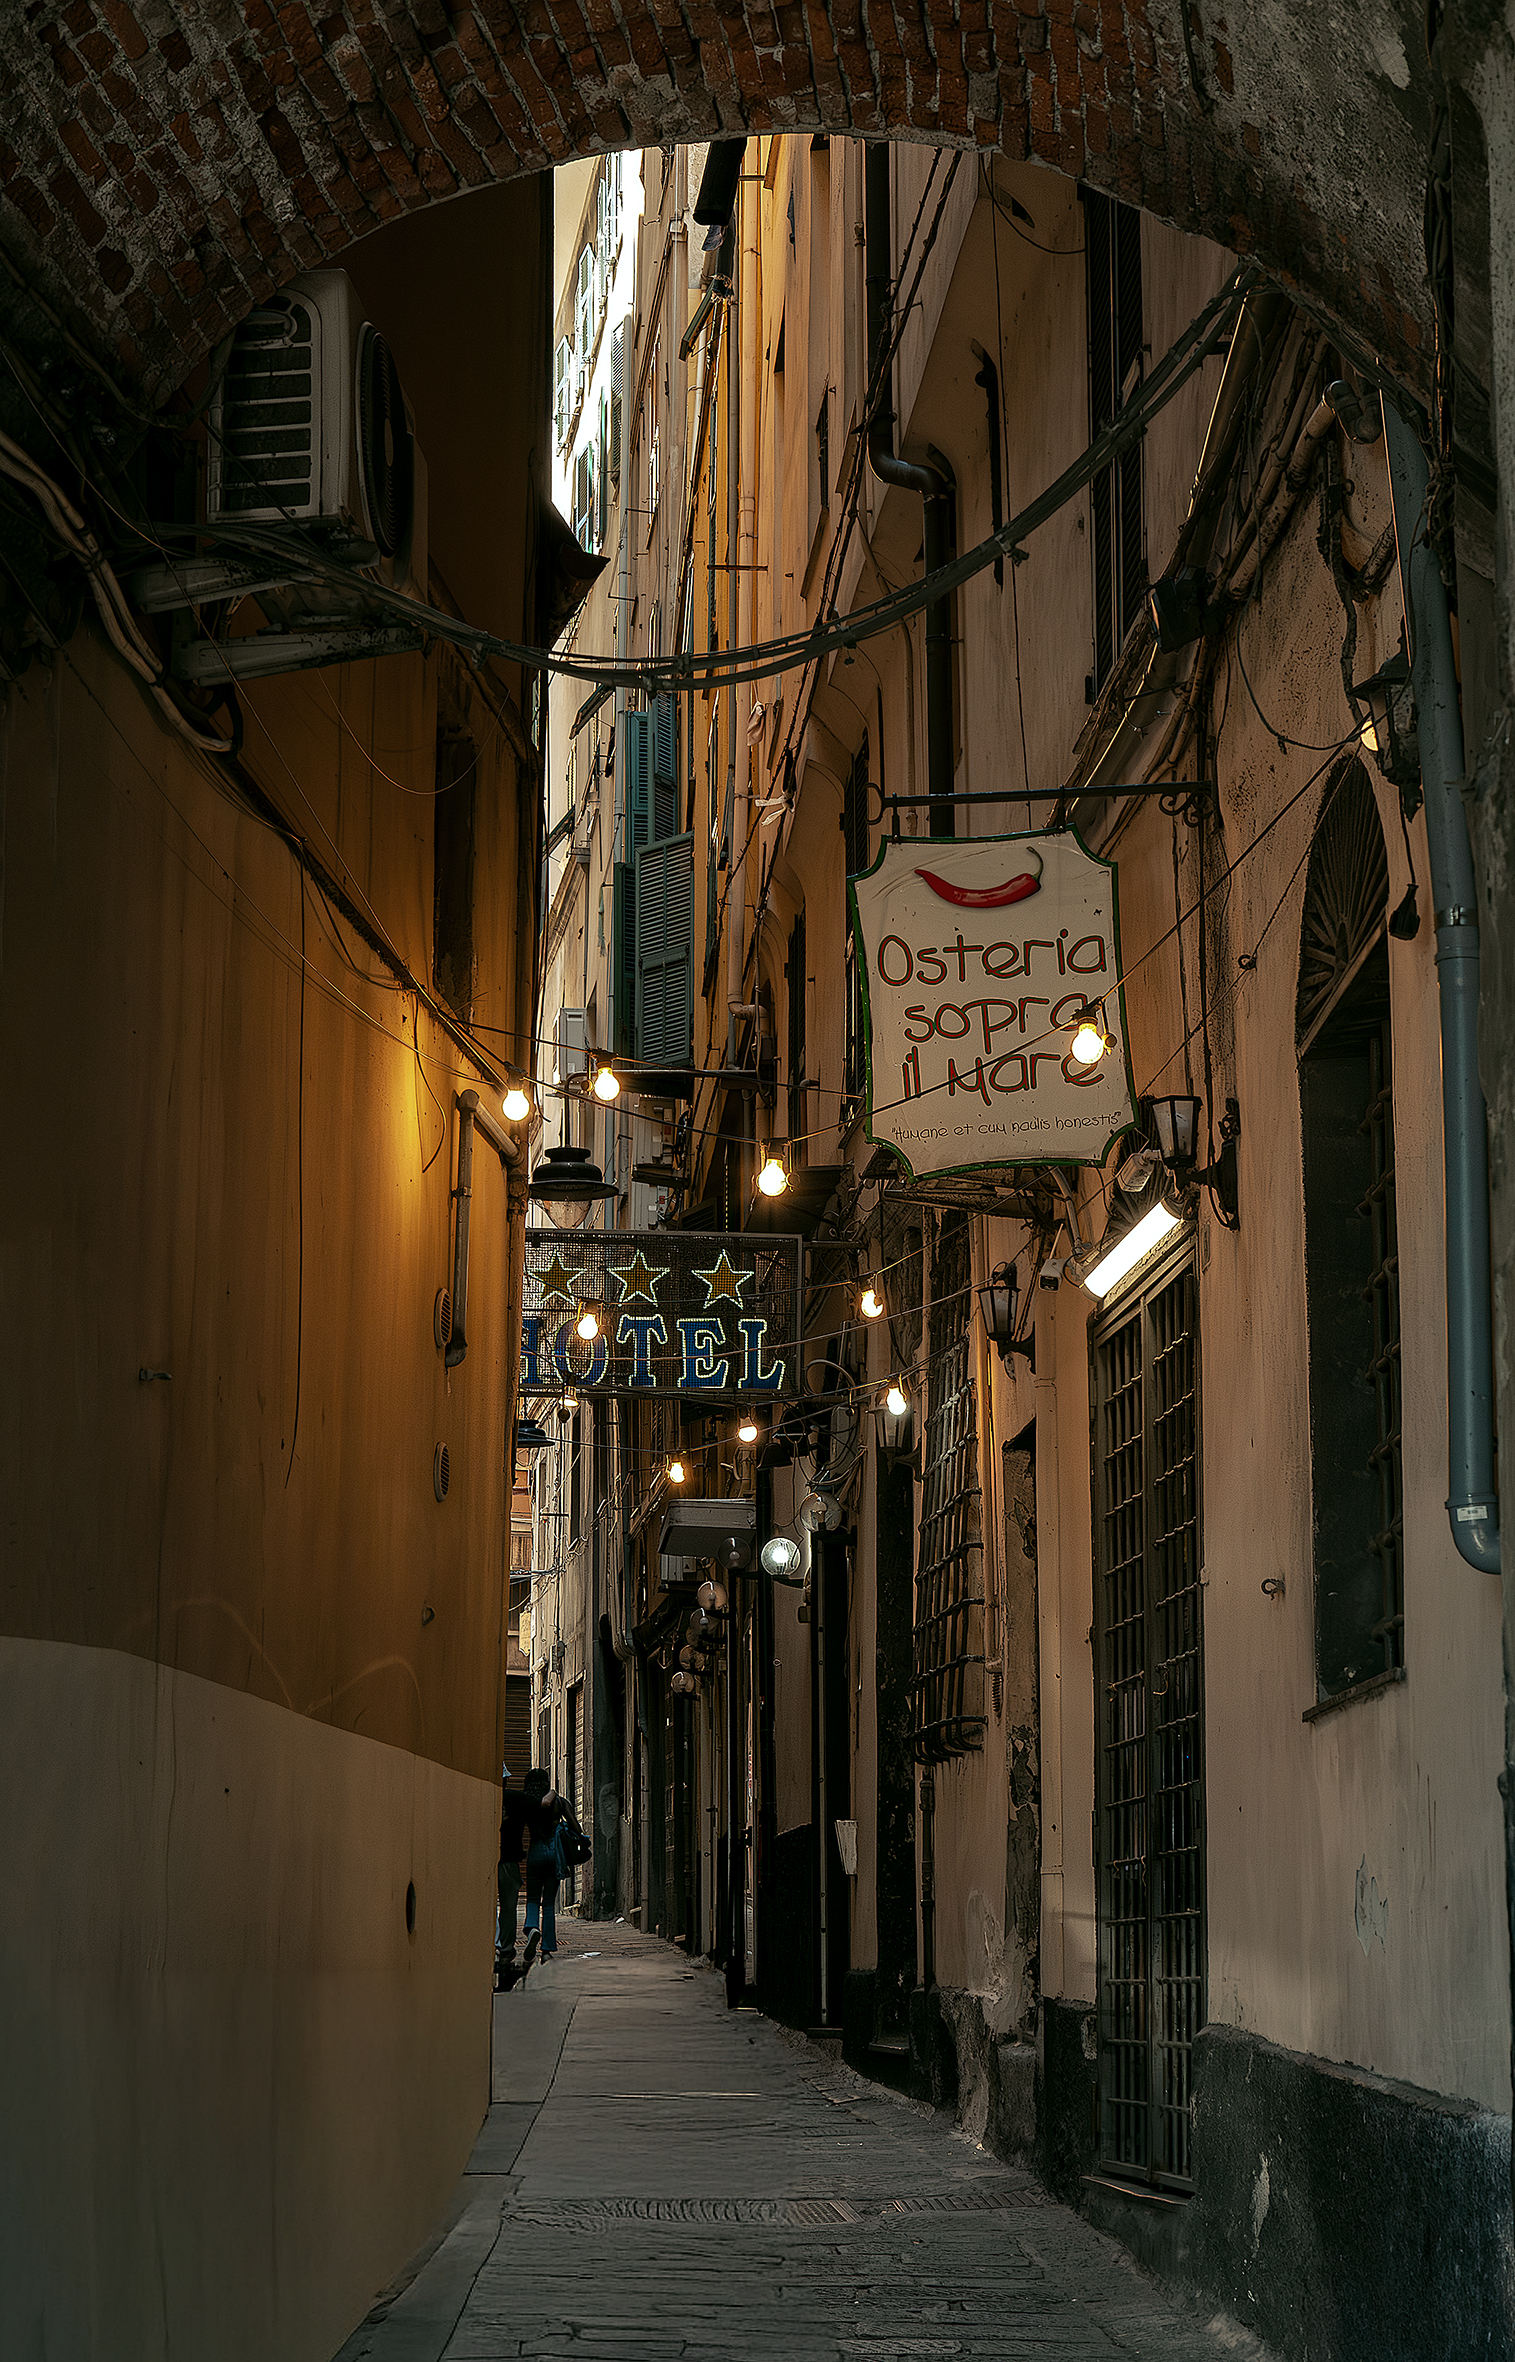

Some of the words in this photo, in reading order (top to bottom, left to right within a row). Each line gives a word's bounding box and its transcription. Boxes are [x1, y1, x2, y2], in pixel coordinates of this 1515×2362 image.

[878, 929, 1107, 986] Osteria
[904, 993, 1090, 1054] sopra
[902, 1046, 922, 1099] il
[953, 1123, 974, 1136] et
